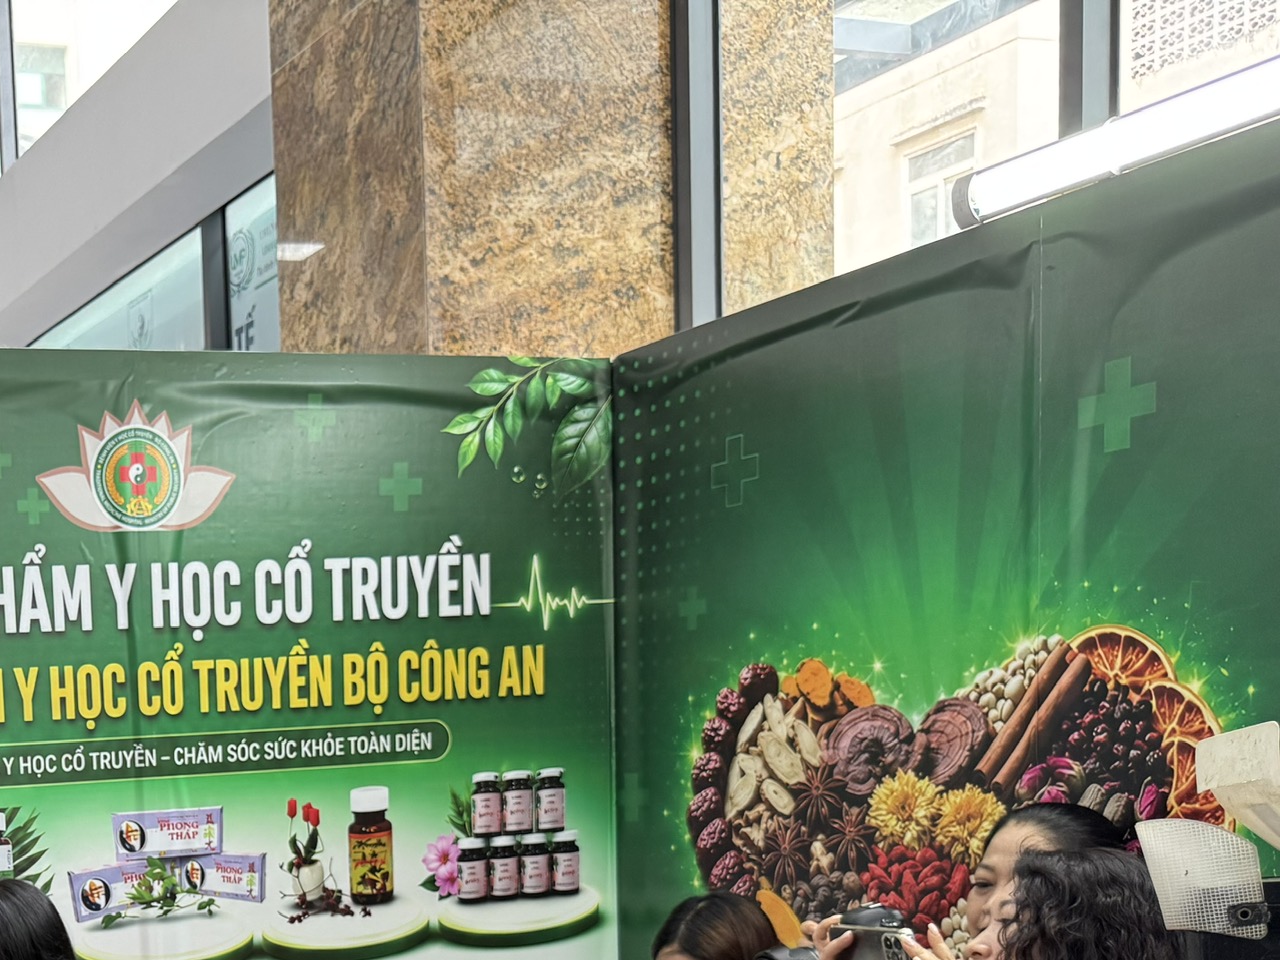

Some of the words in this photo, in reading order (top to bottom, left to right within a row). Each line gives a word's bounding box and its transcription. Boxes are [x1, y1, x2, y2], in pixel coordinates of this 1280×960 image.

[104, 562, 138, 631] Y
[150, 559, 242, 642] HỌC
[254, 538, 313, 626] CỔ
[324, 534, 491, 622] TRUYỀN
[14, 667, 39, 722] Y
[49, 663, 127, 730] HỌC
[137, 642, 184, 717] CỔ
[192, 638, 333, 714] TRUYỀN
[342, 640, 389, 715] BỘ
[398, 639, 491, 703] CÔNG
[498, 644, 545, 698] AN
[2, 756, 15, 775] Y
[19, 754, 57, 778] HỌC
[61, 745, 86, 771] CỔ
[89, 743, 157, 771] TRUYỀN
[173, 737, 222, 766] CHĂM
[226, 736, 260, 763] SÓC
[264, 736, 298, 761] SỨC
[300, 733, 345, 758] KHỎE
[347, 731, 391, 756] TOÀN
[394, 730, 433, 756] DIỆN
